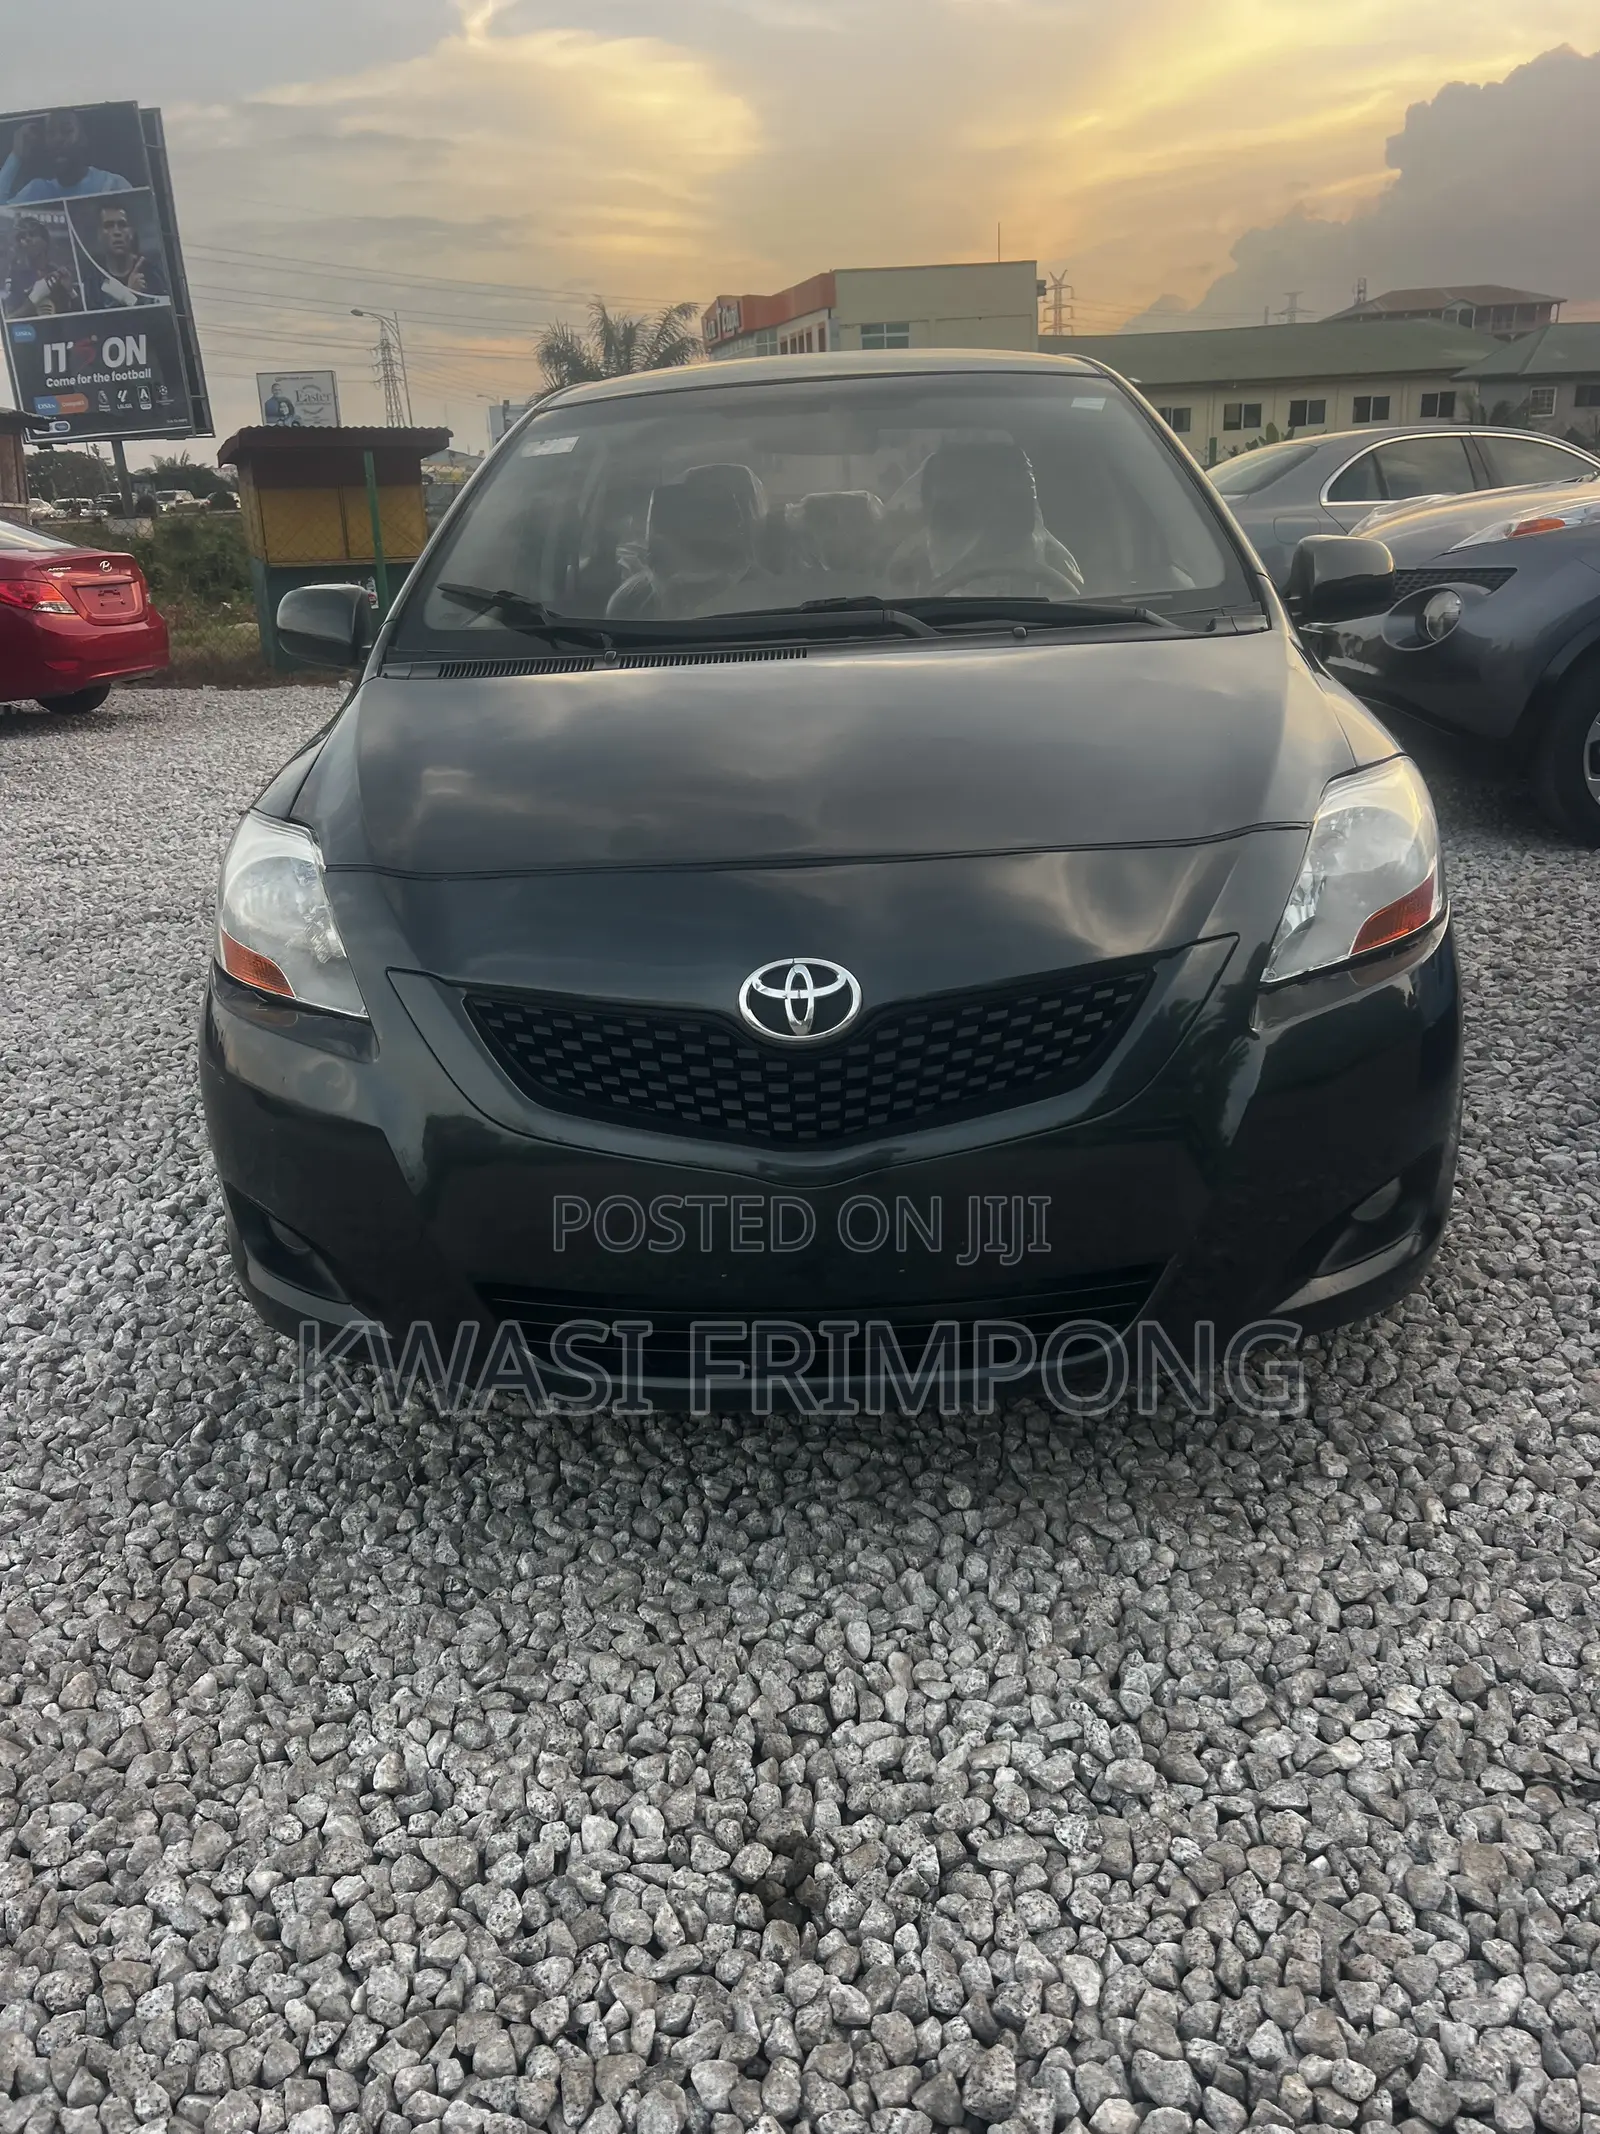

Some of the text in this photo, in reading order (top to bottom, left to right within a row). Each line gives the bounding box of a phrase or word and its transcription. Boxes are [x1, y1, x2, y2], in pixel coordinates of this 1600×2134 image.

[102, 334, 147, 368] ON
[46, 368, 152, 388] Come for the football
[294, 389, 332, 402] Easter
